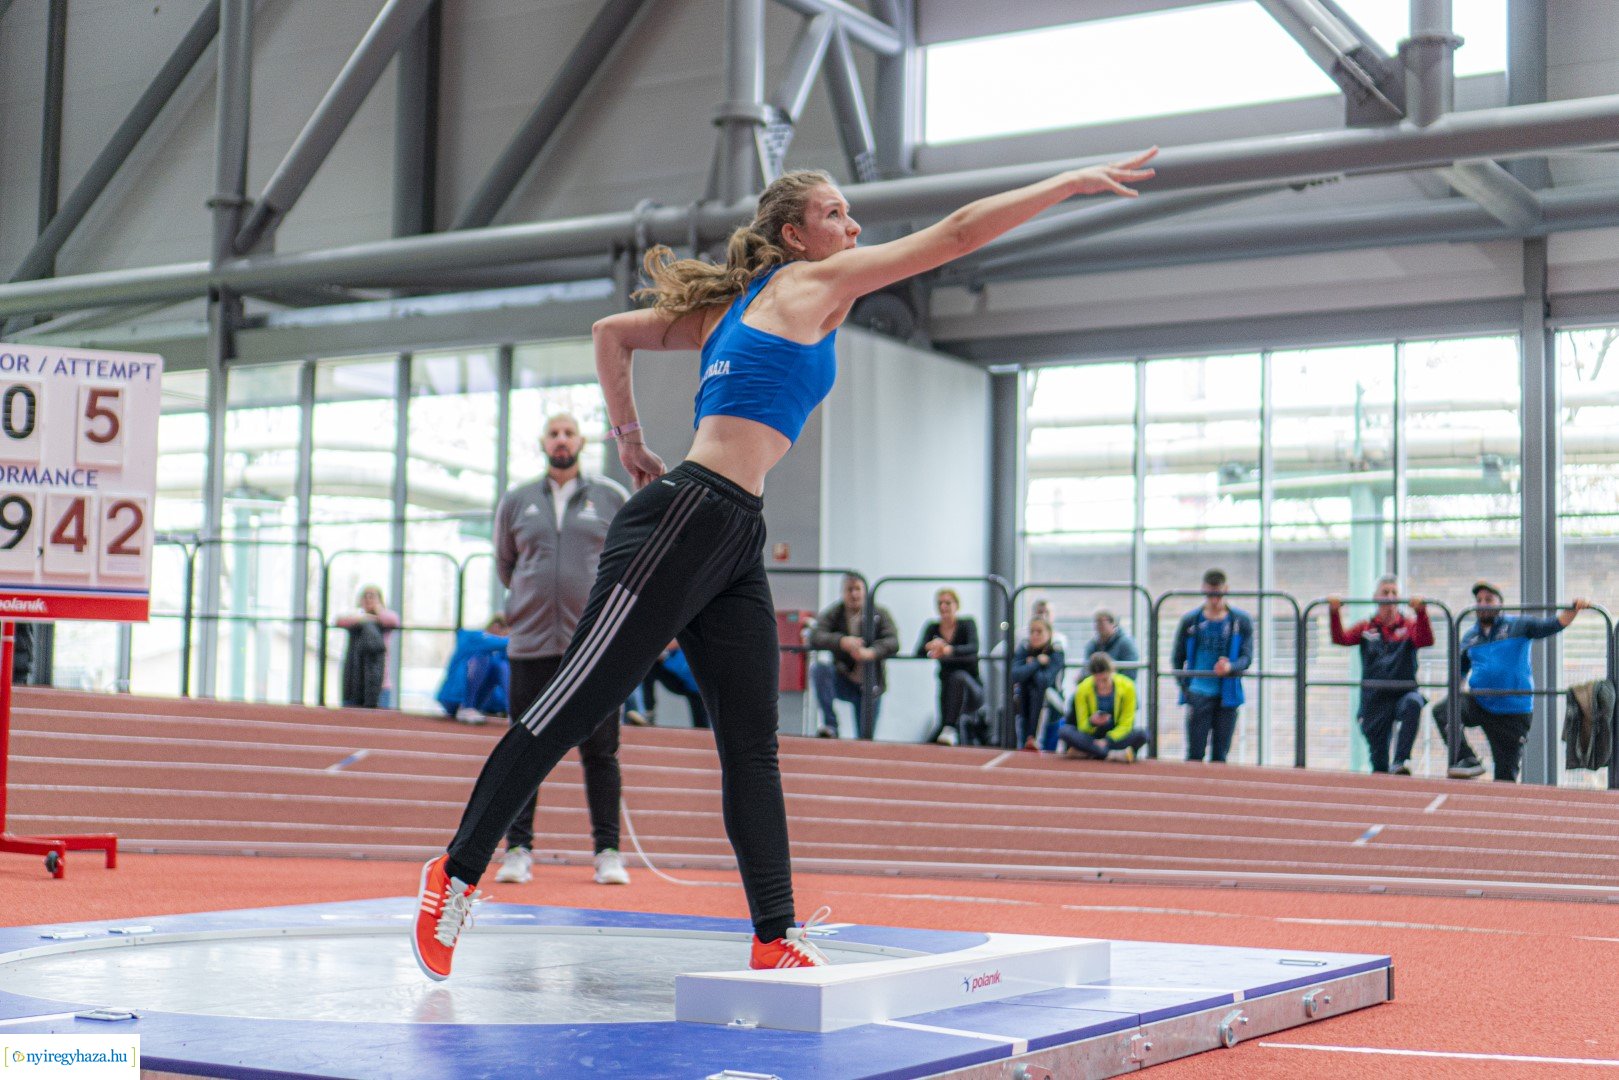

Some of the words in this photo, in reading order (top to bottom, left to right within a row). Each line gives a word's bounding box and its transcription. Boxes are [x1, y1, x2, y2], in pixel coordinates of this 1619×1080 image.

[0, 353, 29, 372] OR
[38, 355, 48, 373] /
[53, 357, 156, 380] ATTEMPT
[2, 384, 36, 439] 0
[85, 387, 120, 443] 5
[0, 597, 48, 613] olanik
[971, 969, 1002, 992] polanik
